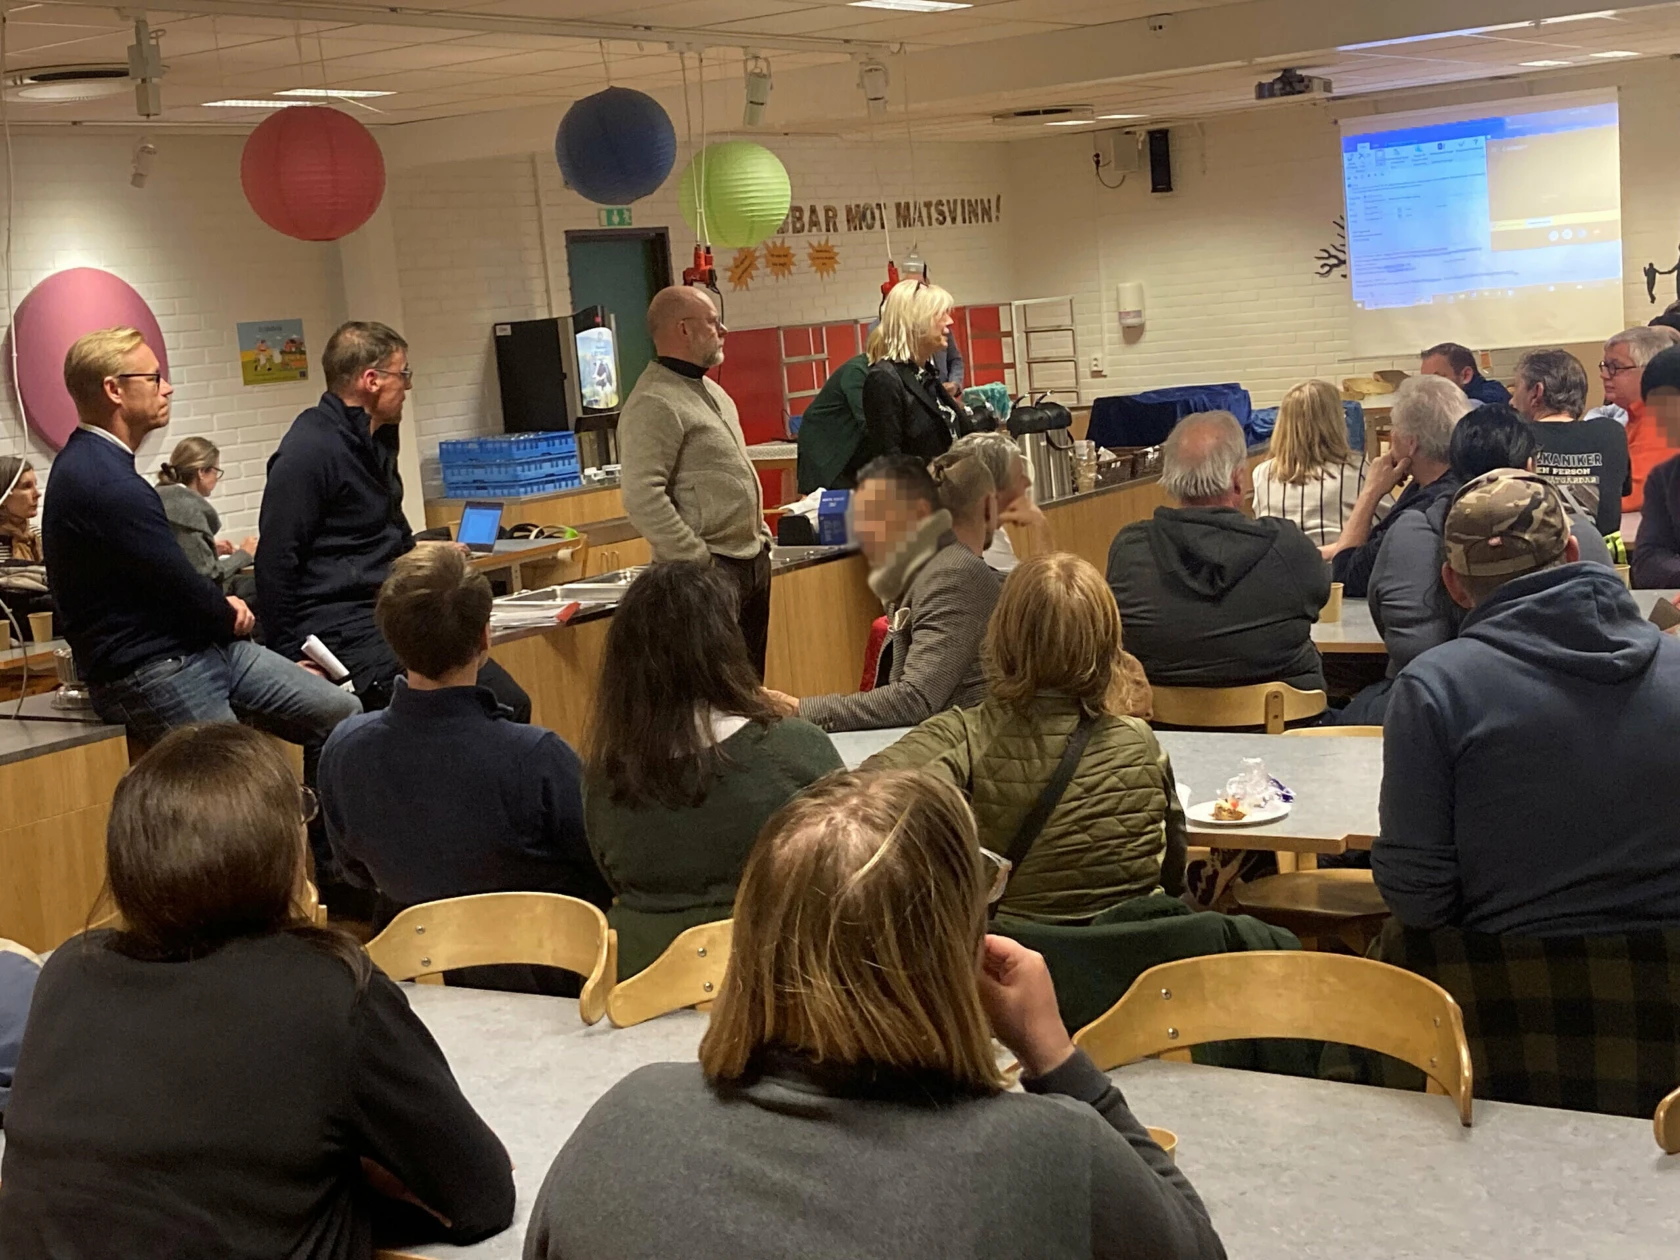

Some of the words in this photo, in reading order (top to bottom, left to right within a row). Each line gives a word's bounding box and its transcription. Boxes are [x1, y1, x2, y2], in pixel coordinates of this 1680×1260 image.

[845, 202, 887, 231] MOT
[894, 194, 1001, 229] MATSVINN!
[1553, 467, 1590, 475] PERSON
